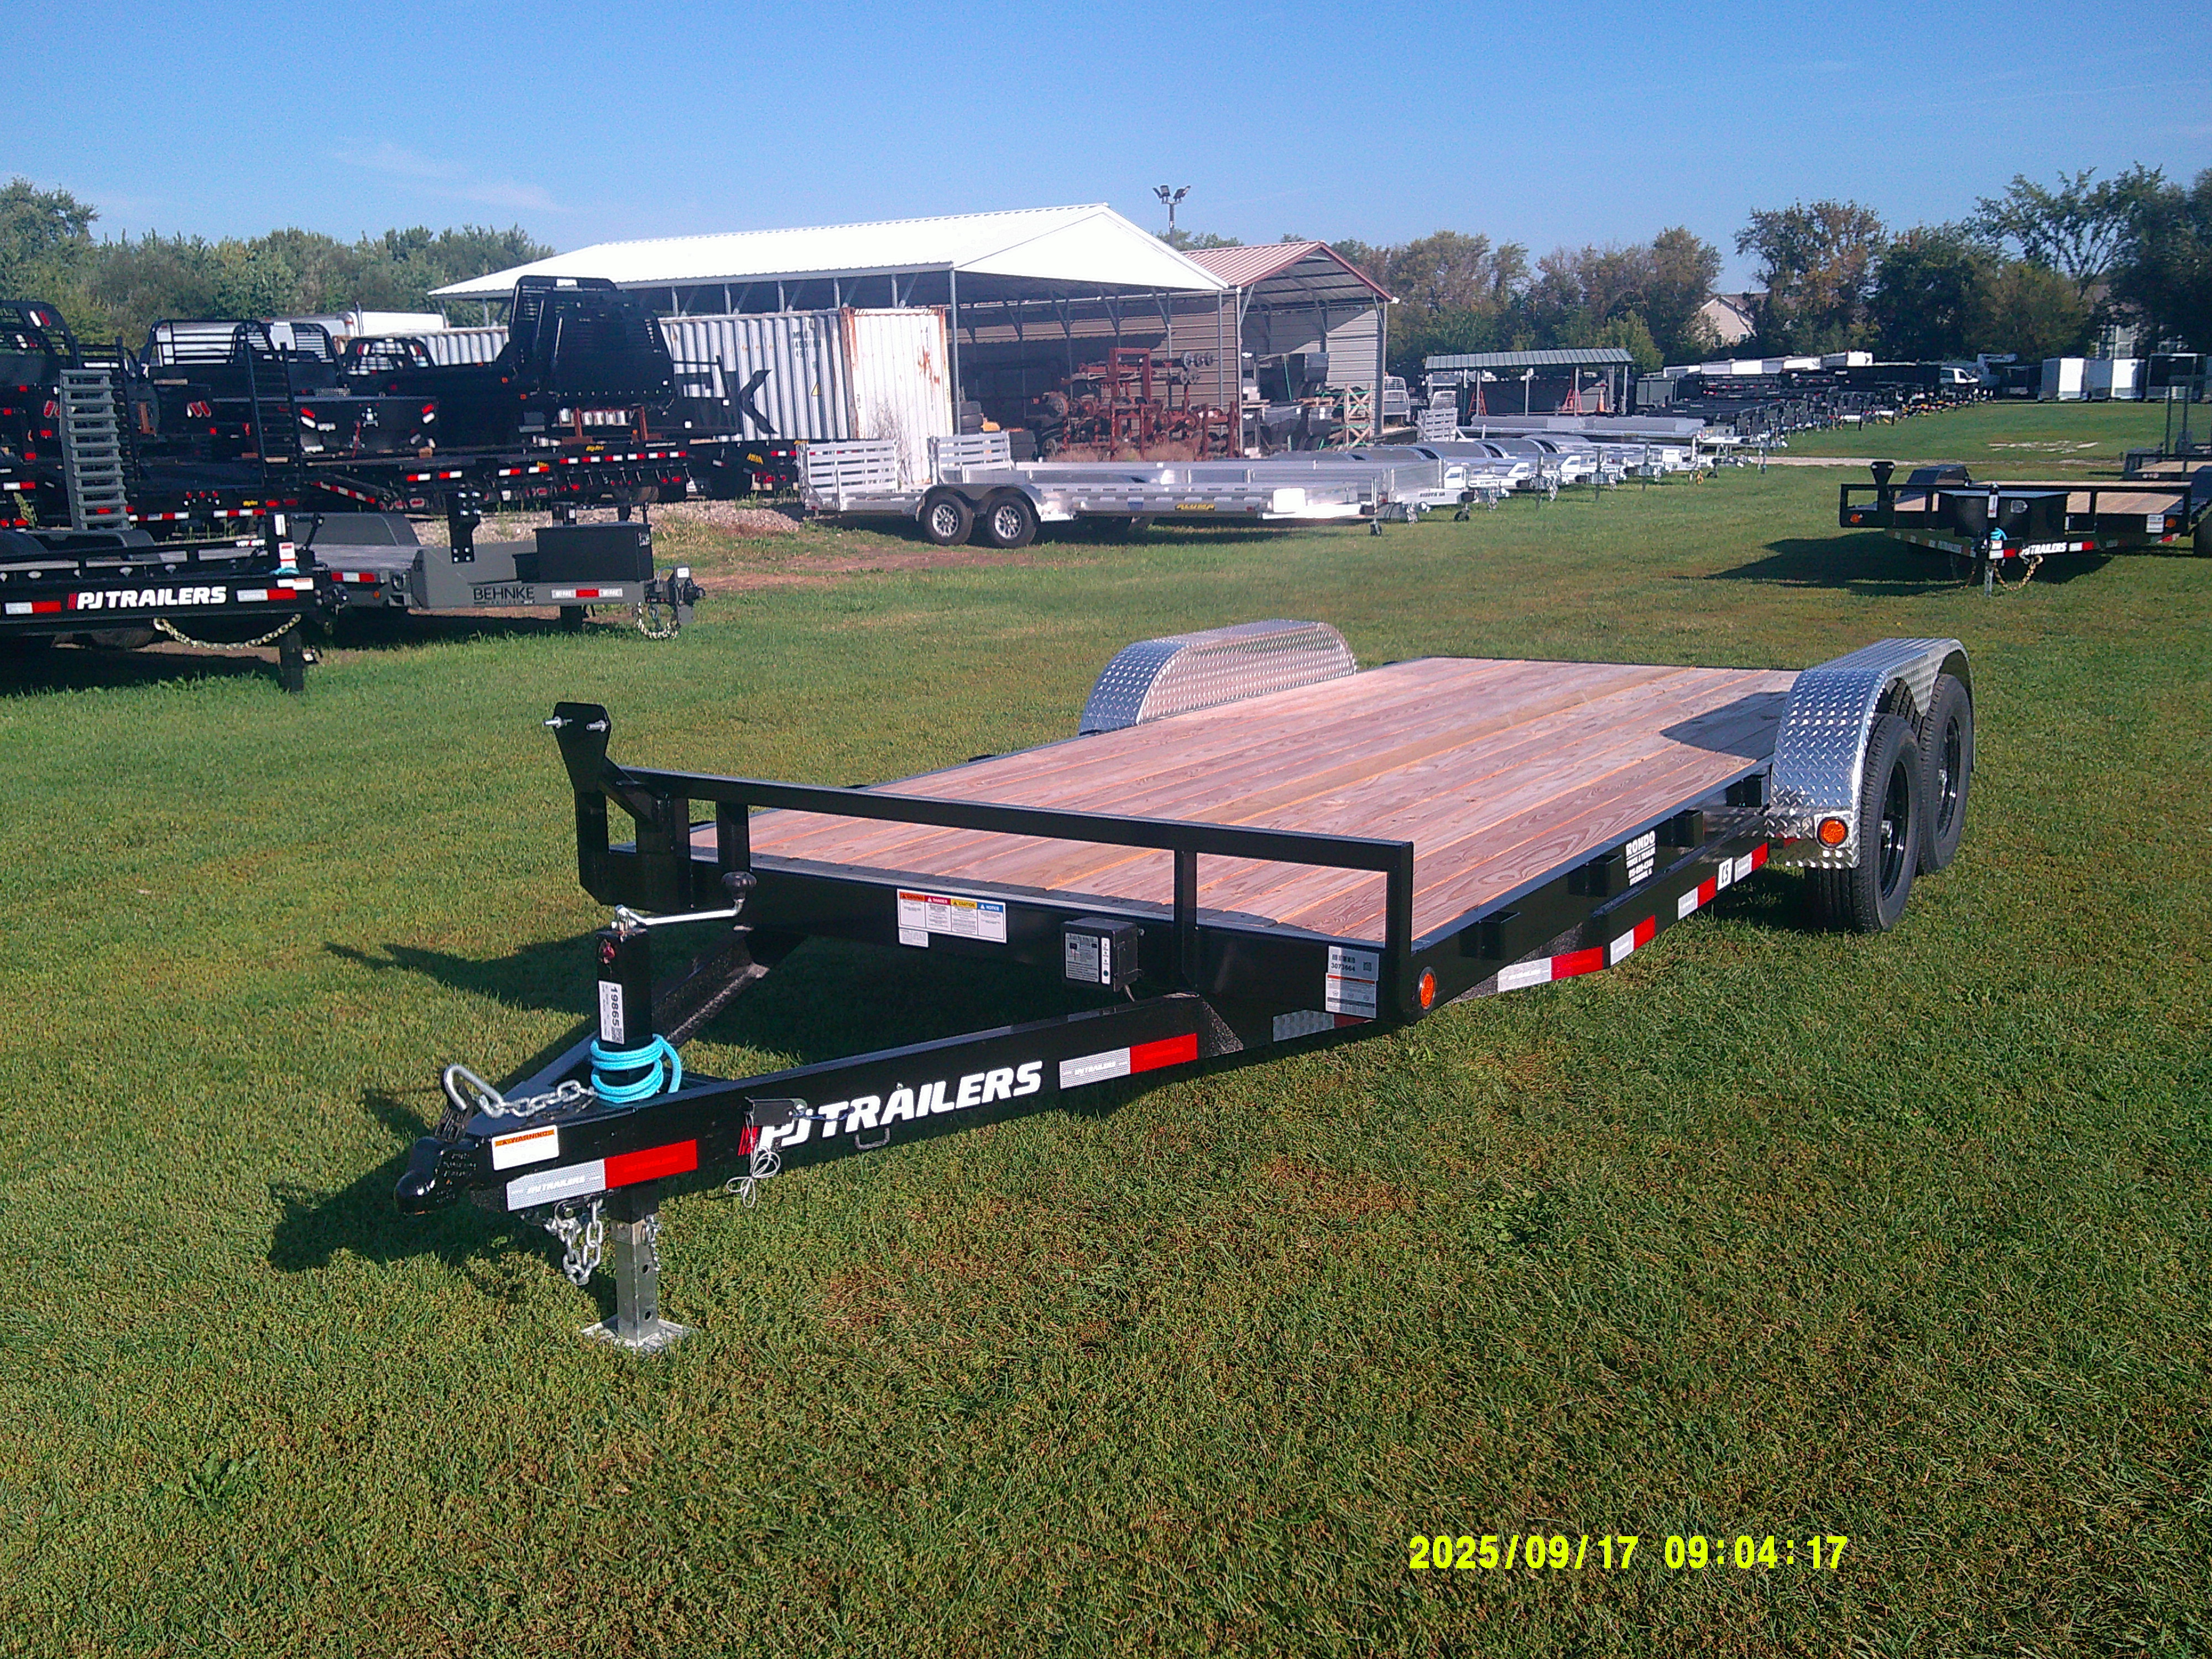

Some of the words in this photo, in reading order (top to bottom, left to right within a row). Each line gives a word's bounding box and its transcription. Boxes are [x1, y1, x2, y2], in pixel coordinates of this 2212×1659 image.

[77, 592, 104, 610] PJ
[106, 586, 227, 608] TRAILERS
[473, 587, 535, 600] BEHNKE
[1626, 830, 1655, 857] RONDO
[611, 985, 620, 1027] 19865
[817, 1060, 1042, 1139] TRAILERS
[511, 1130, 549, 1143] WARNING
